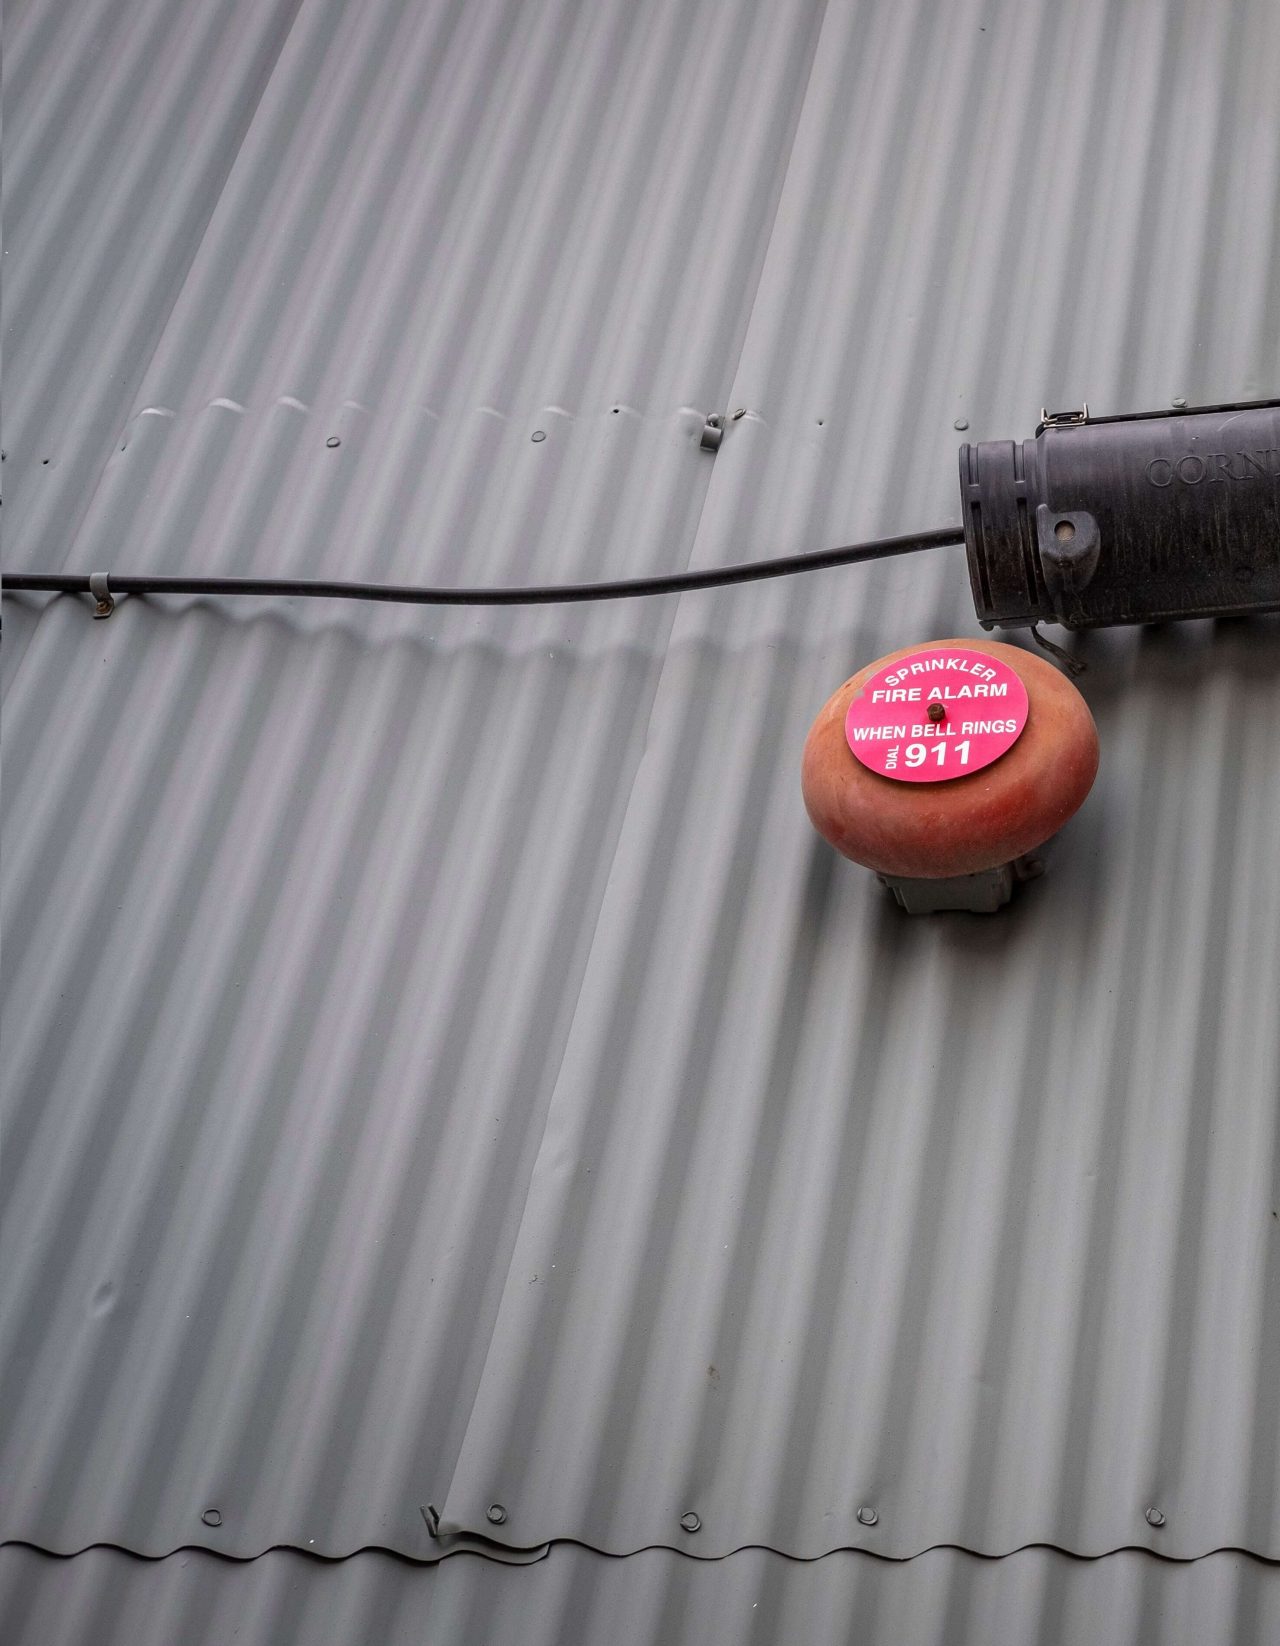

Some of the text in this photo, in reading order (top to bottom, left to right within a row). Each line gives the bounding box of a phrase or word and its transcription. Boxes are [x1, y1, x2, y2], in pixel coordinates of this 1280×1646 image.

[884, 658, 997, 687] SPRINKLER
[871, 683, 1008, 703] FIRE ALARM
[853, 719, 1017, 741] WHEN BELL RINGS
[885, 745, 900, 770] DIAL
[904, 740, 971, 768] 911
